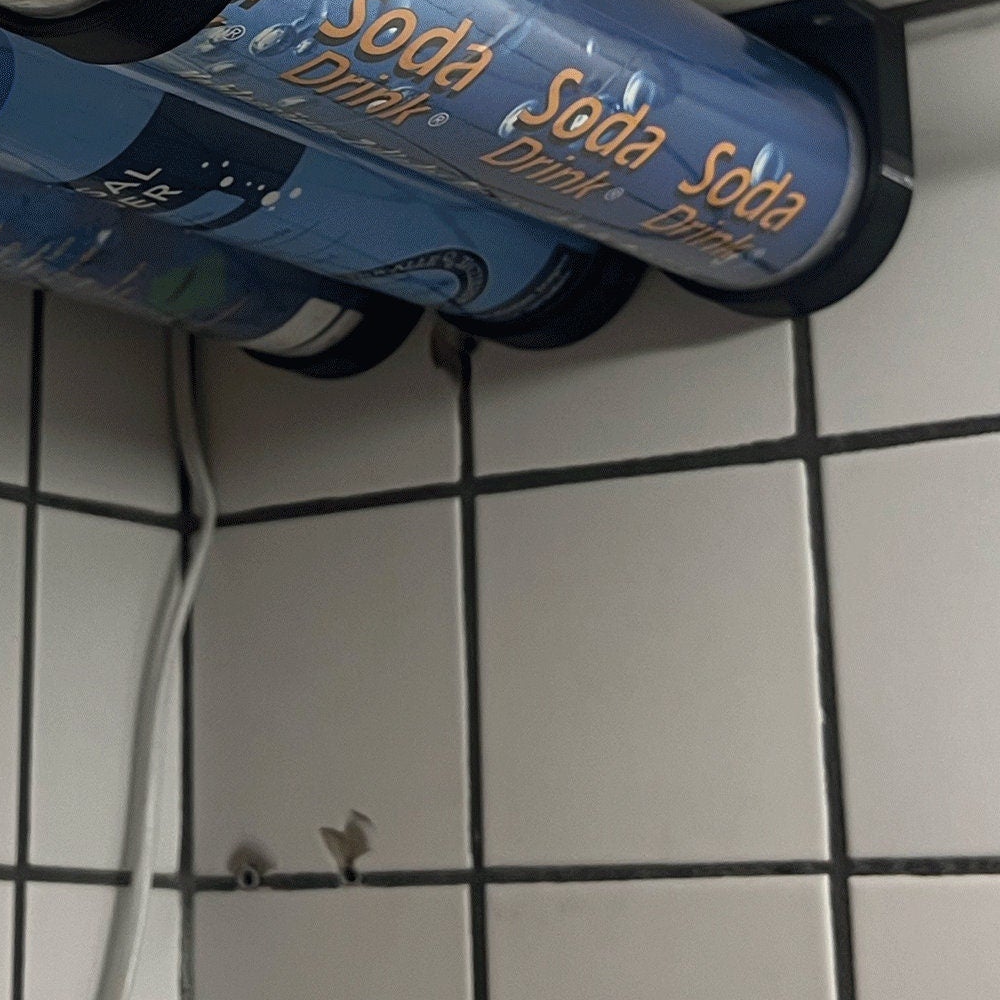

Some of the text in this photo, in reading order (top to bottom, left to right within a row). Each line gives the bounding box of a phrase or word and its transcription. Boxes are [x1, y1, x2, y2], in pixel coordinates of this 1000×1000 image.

[279, 50, 432, 126] Drink
[517, 67, 667, 171] Soda
[479, 136, 611, 200] Drink
[677, 141, 808, 232] Soda
[642, 203, 755, 260] Drink
